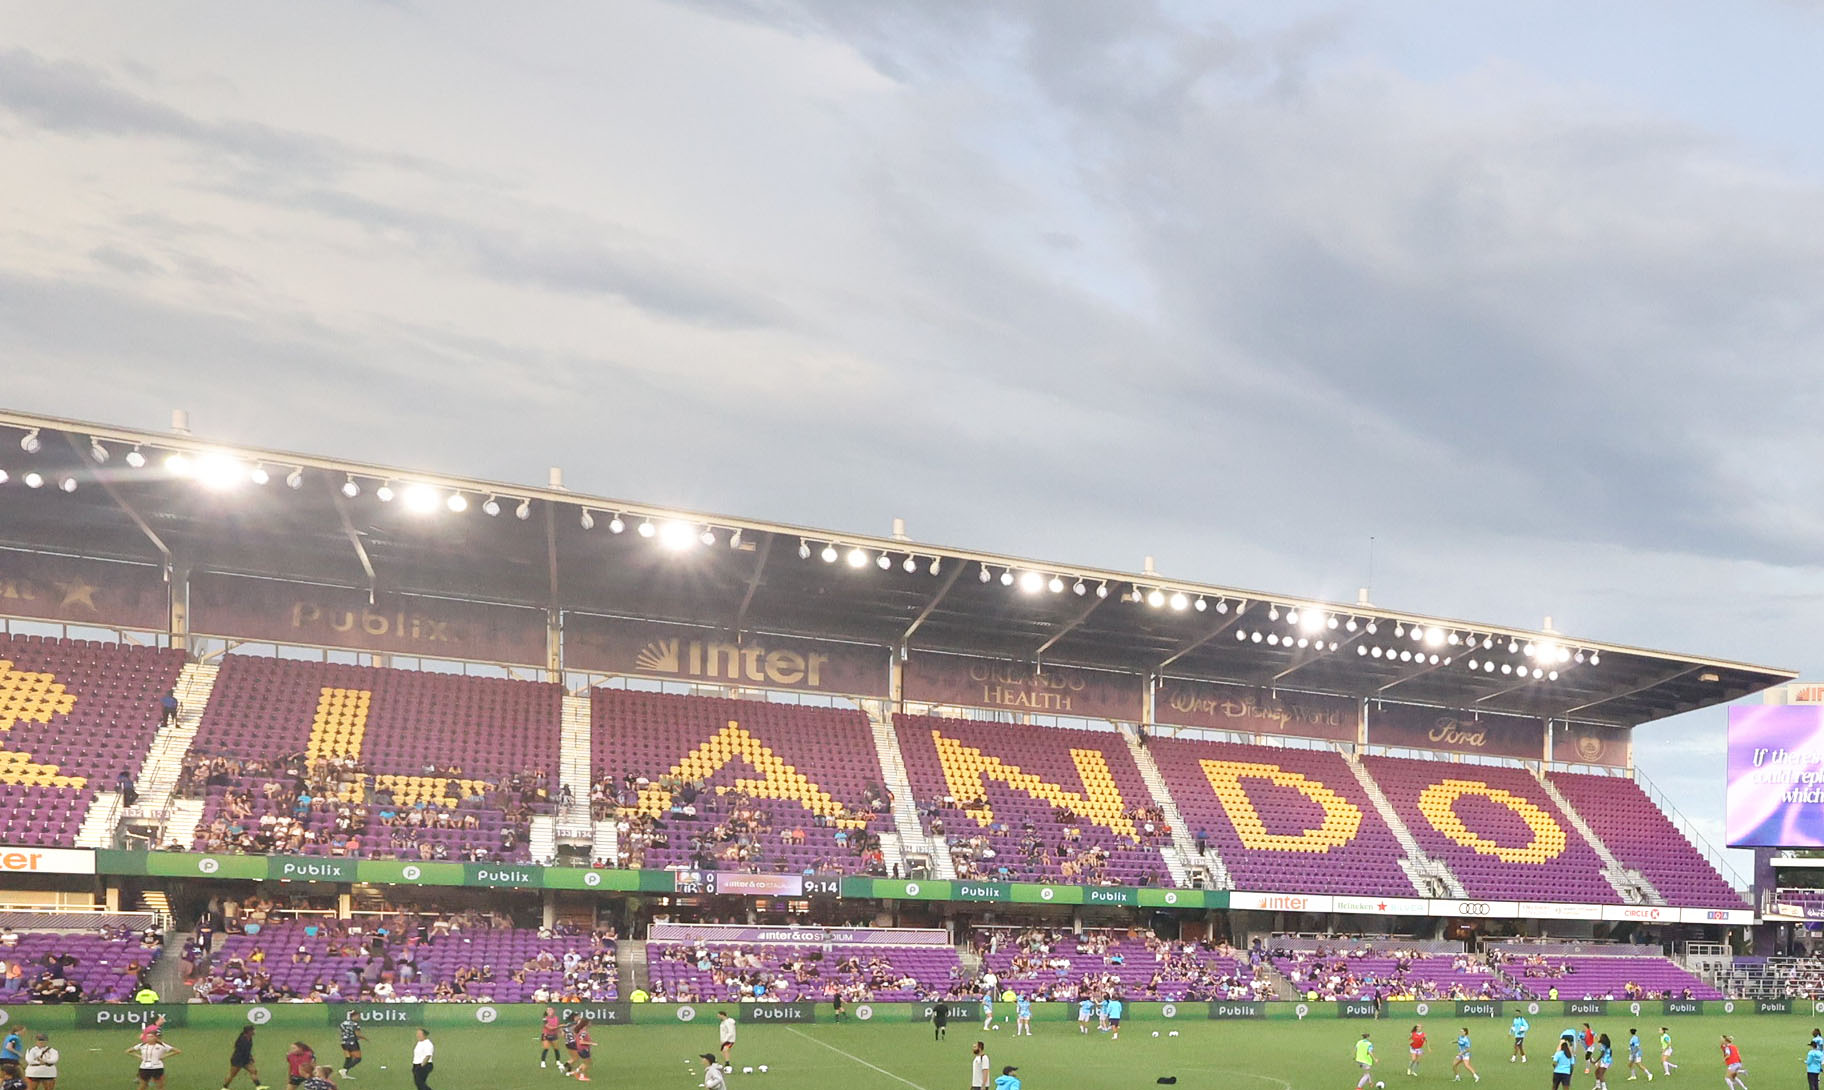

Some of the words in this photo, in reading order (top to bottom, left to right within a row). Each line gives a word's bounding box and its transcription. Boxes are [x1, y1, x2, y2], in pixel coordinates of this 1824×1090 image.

[688, 639, 829, 687] inter
[970, 663, 1086, 691] ORLANDO
[983, 686, 1073, 711] HEALTH
[1429, 716, 1487, 747] Ford
[1752, 748, 1768, 767] If
[1780, 787, 1824, 804] which
[284, 863, 342, 876] Publix
[477, 870, 529, 882] Publix
[706, 873, 715, 883] 0
[706, 883, 715, 893] 0
[804, 881, 838, 893] 9:14
[960, 886, 1000, 897] Publix
[1091, 890, 1127, 901] Publix
[1269, 896, 1308, 910] inter
[1337, 902, 1374, 911] Heineken
[1624, 909, 1649, 918] CIRCLE
[814, 934, 853, 942] STDIUM
[753, 1007, 801, 1018] Publix
[1219, 1005, 1255, 1016] Publix
[1346, 1005, 1375, 1015] Publi
[1464, 1005, 1494, 1014] Publix
[1571, 1004, 1600, 1013] Publix
[1669, 1003, 1696, 1013] Publix
[1761, 1003, 1786, 1011] Publix
